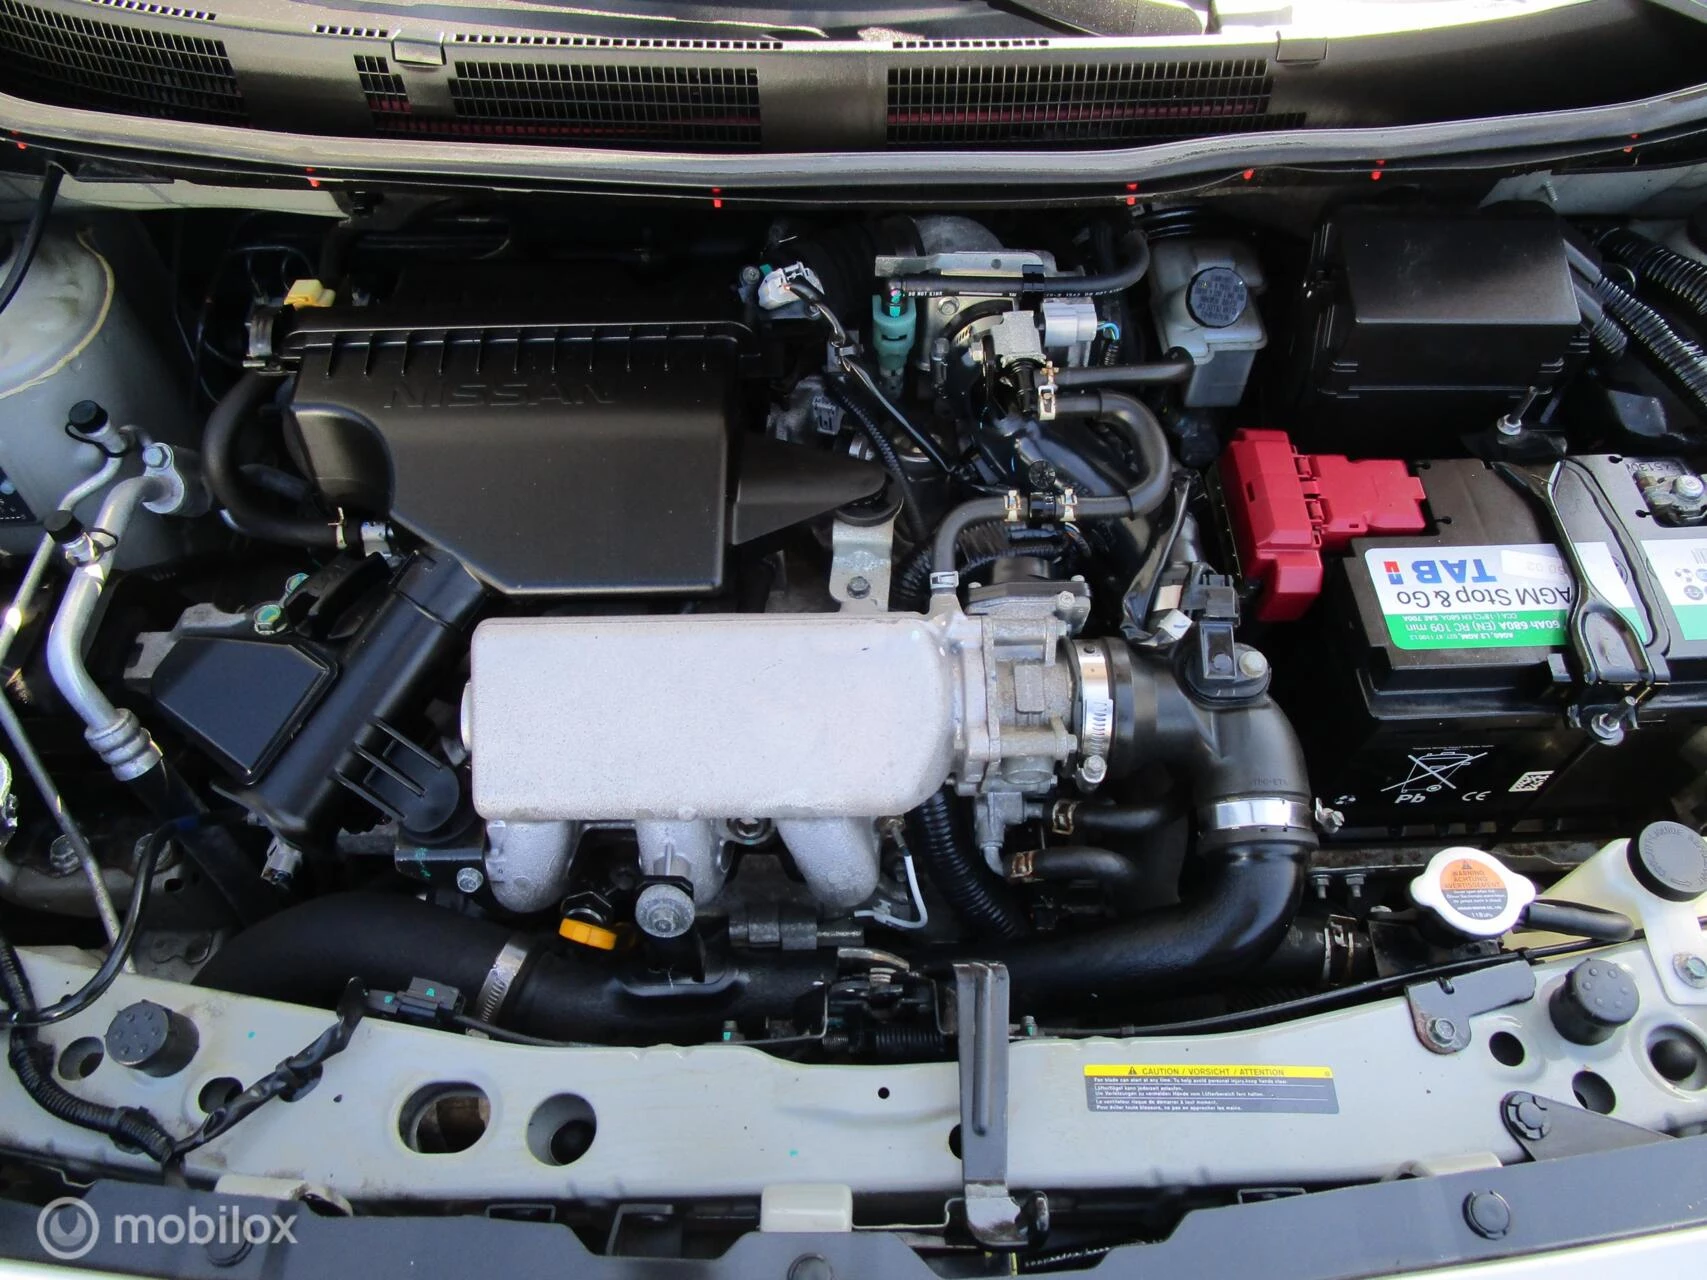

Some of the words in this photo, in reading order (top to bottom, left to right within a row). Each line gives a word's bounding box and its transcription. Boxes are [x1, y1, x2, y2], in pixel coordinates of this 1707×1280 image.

[383, 383, 615, 408] NISSAN
[1411, 559, 1498, 584] TAB
[1396, 590, 1431, 609] Go
[1433, 589, 1452, 609] &
[1455, 585, 1513, 607] Stop
[1515, 586, 1571, 606] AGM
[1405, 623, 1428, 631] min
[1430, 622, 1452, 632] 109
[1454, 622, 1471, 632] RC
[1471, 619, 1497, 632] (EN)
[1497, 620, 1529, 631] 680A
[1394, 793, 1427, 804] Pb
[1142, 1067, 1179, 1075] CAUTION
[1188, 1067, 1230, 1075] VORSICHT
[1240, 1068, 1285, 1076] ATTENTION
